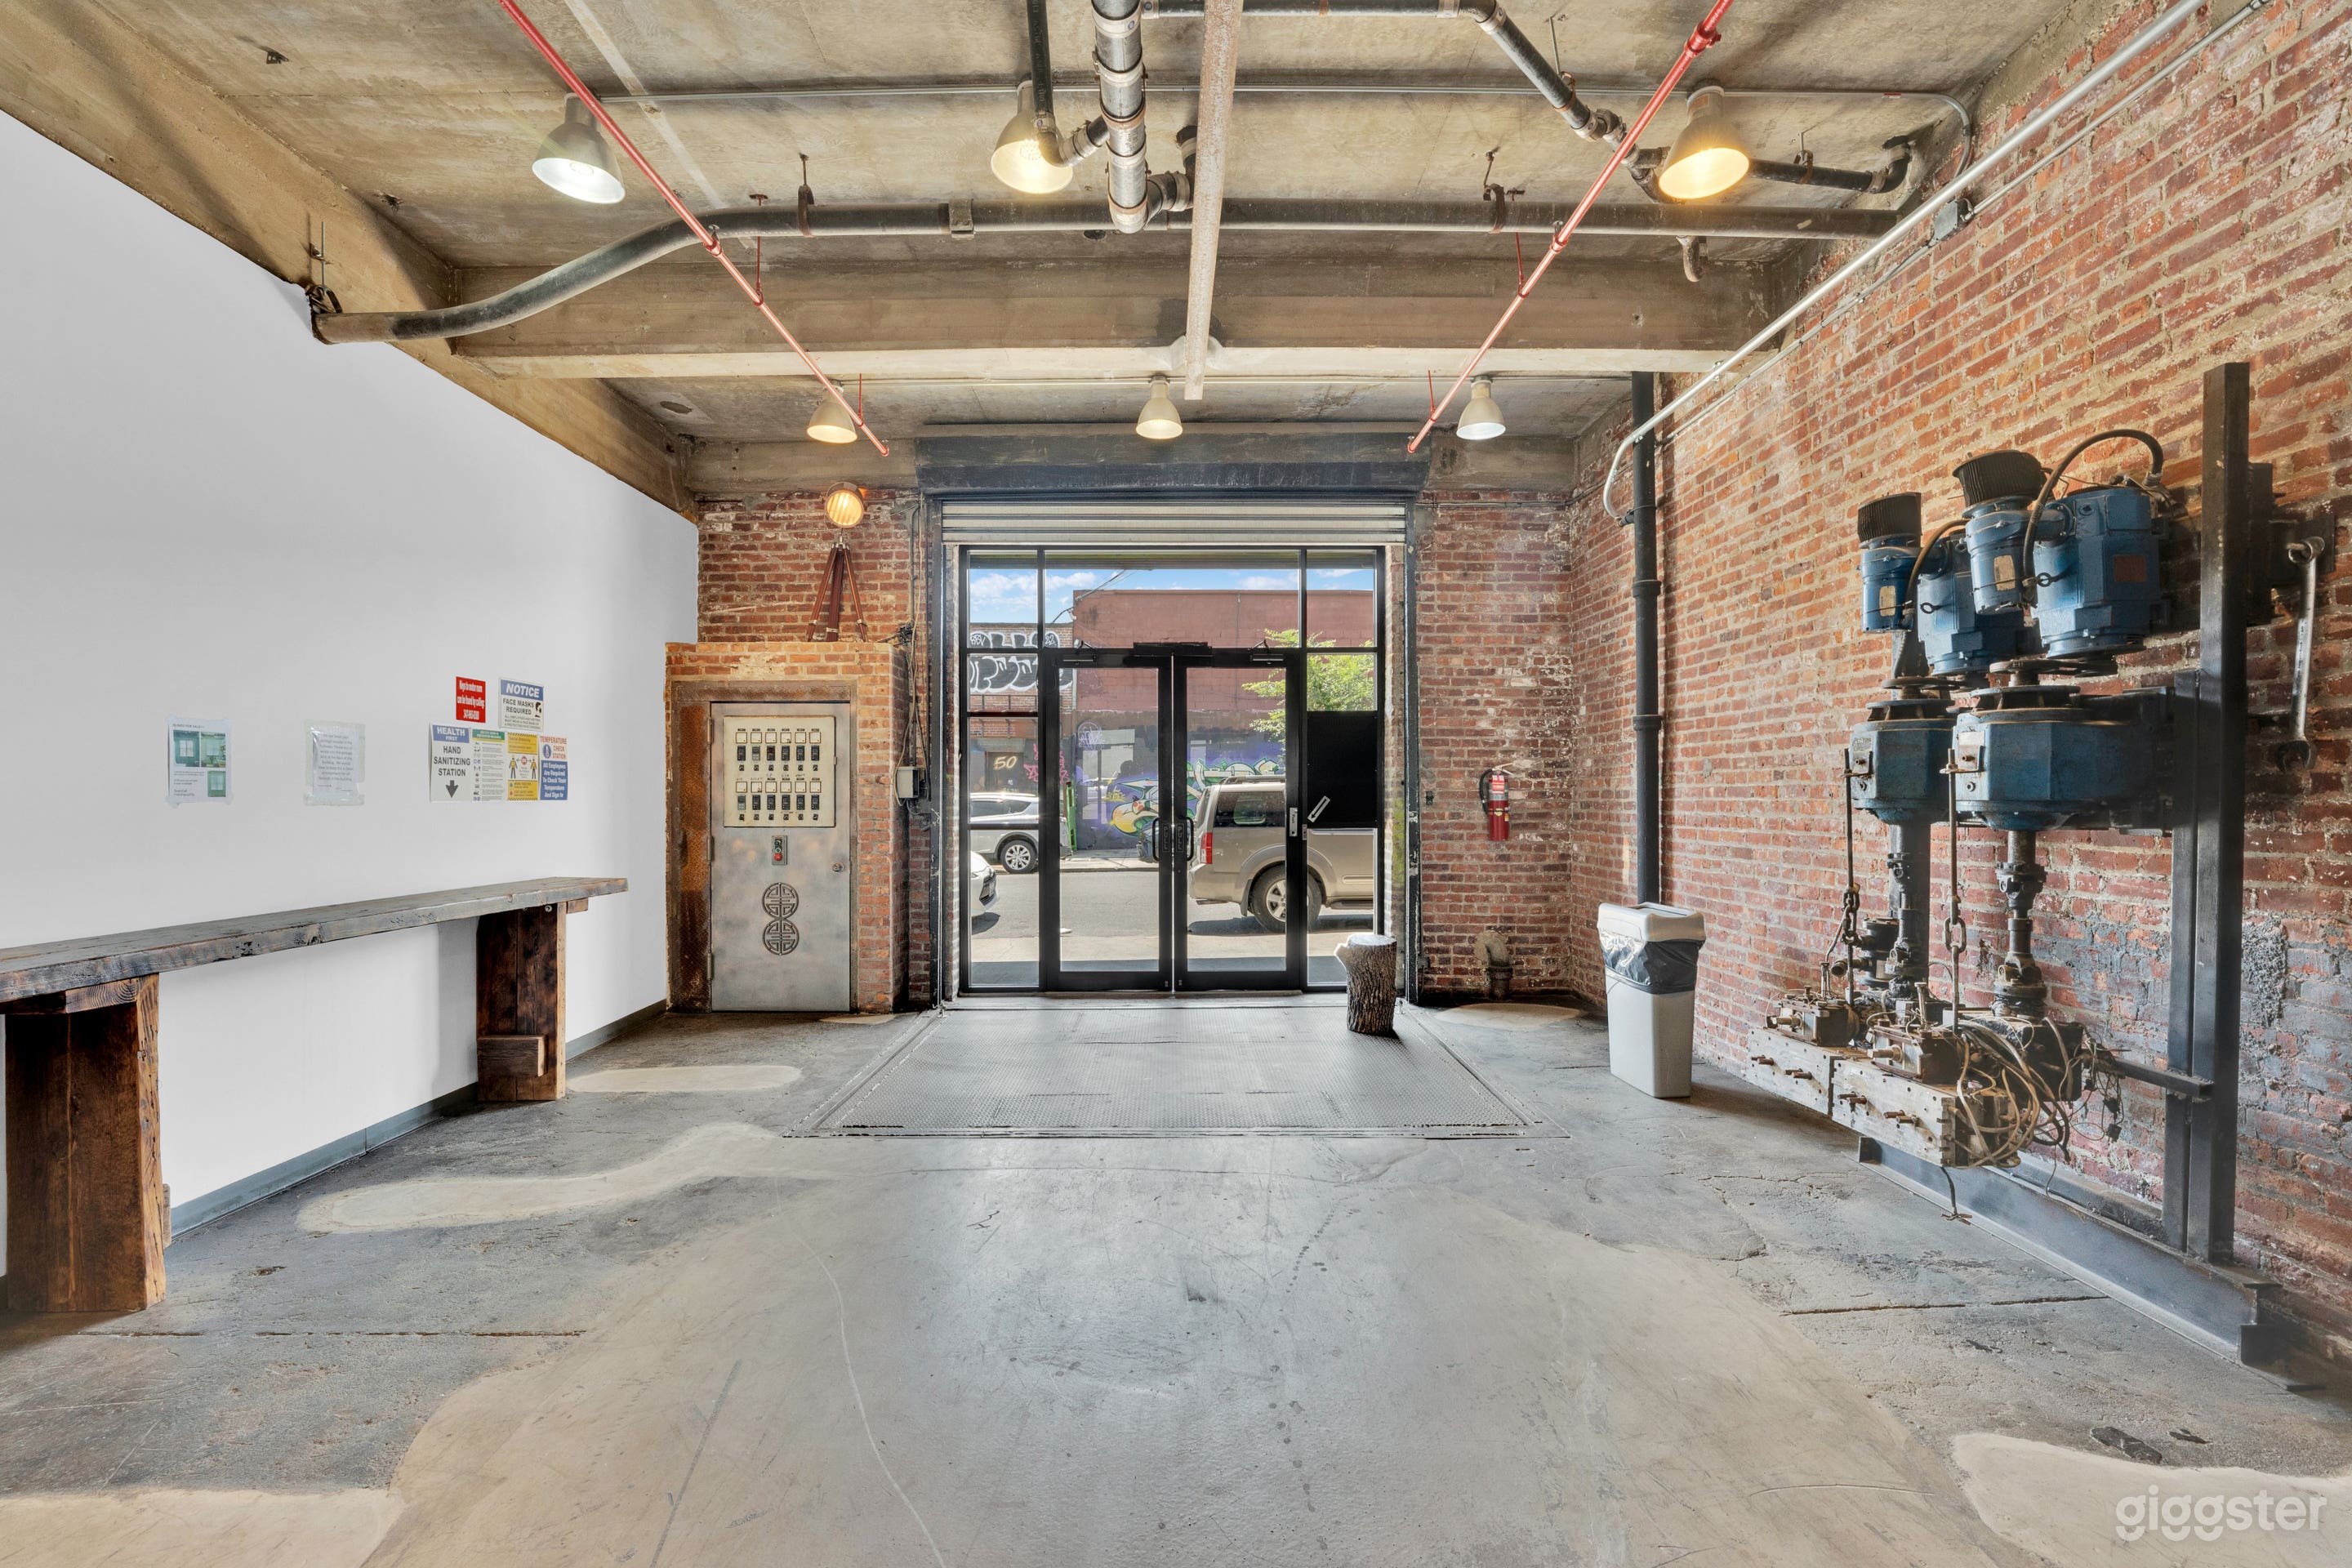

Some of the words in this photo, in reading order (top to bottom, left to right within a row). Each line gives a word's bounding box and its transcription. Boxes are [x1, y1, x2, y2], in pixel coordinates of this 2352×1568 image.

[506, 683, 540, 698] NOTICE
[503, 697, 516, 706] FACE
[518, 700, 534, 708] MASKS
[506, 706, 532, 715] REQUIRED
[437, 727, 466, 736] HEALTH
[540, 736, 568, 745] TEMPERATURE
[443, 745, 461, 755] HAND
[434, 756, 470, 766] SANITIZING
[993, 755, 1018, 770] 50
[438, 768, 466, 777] STATION
